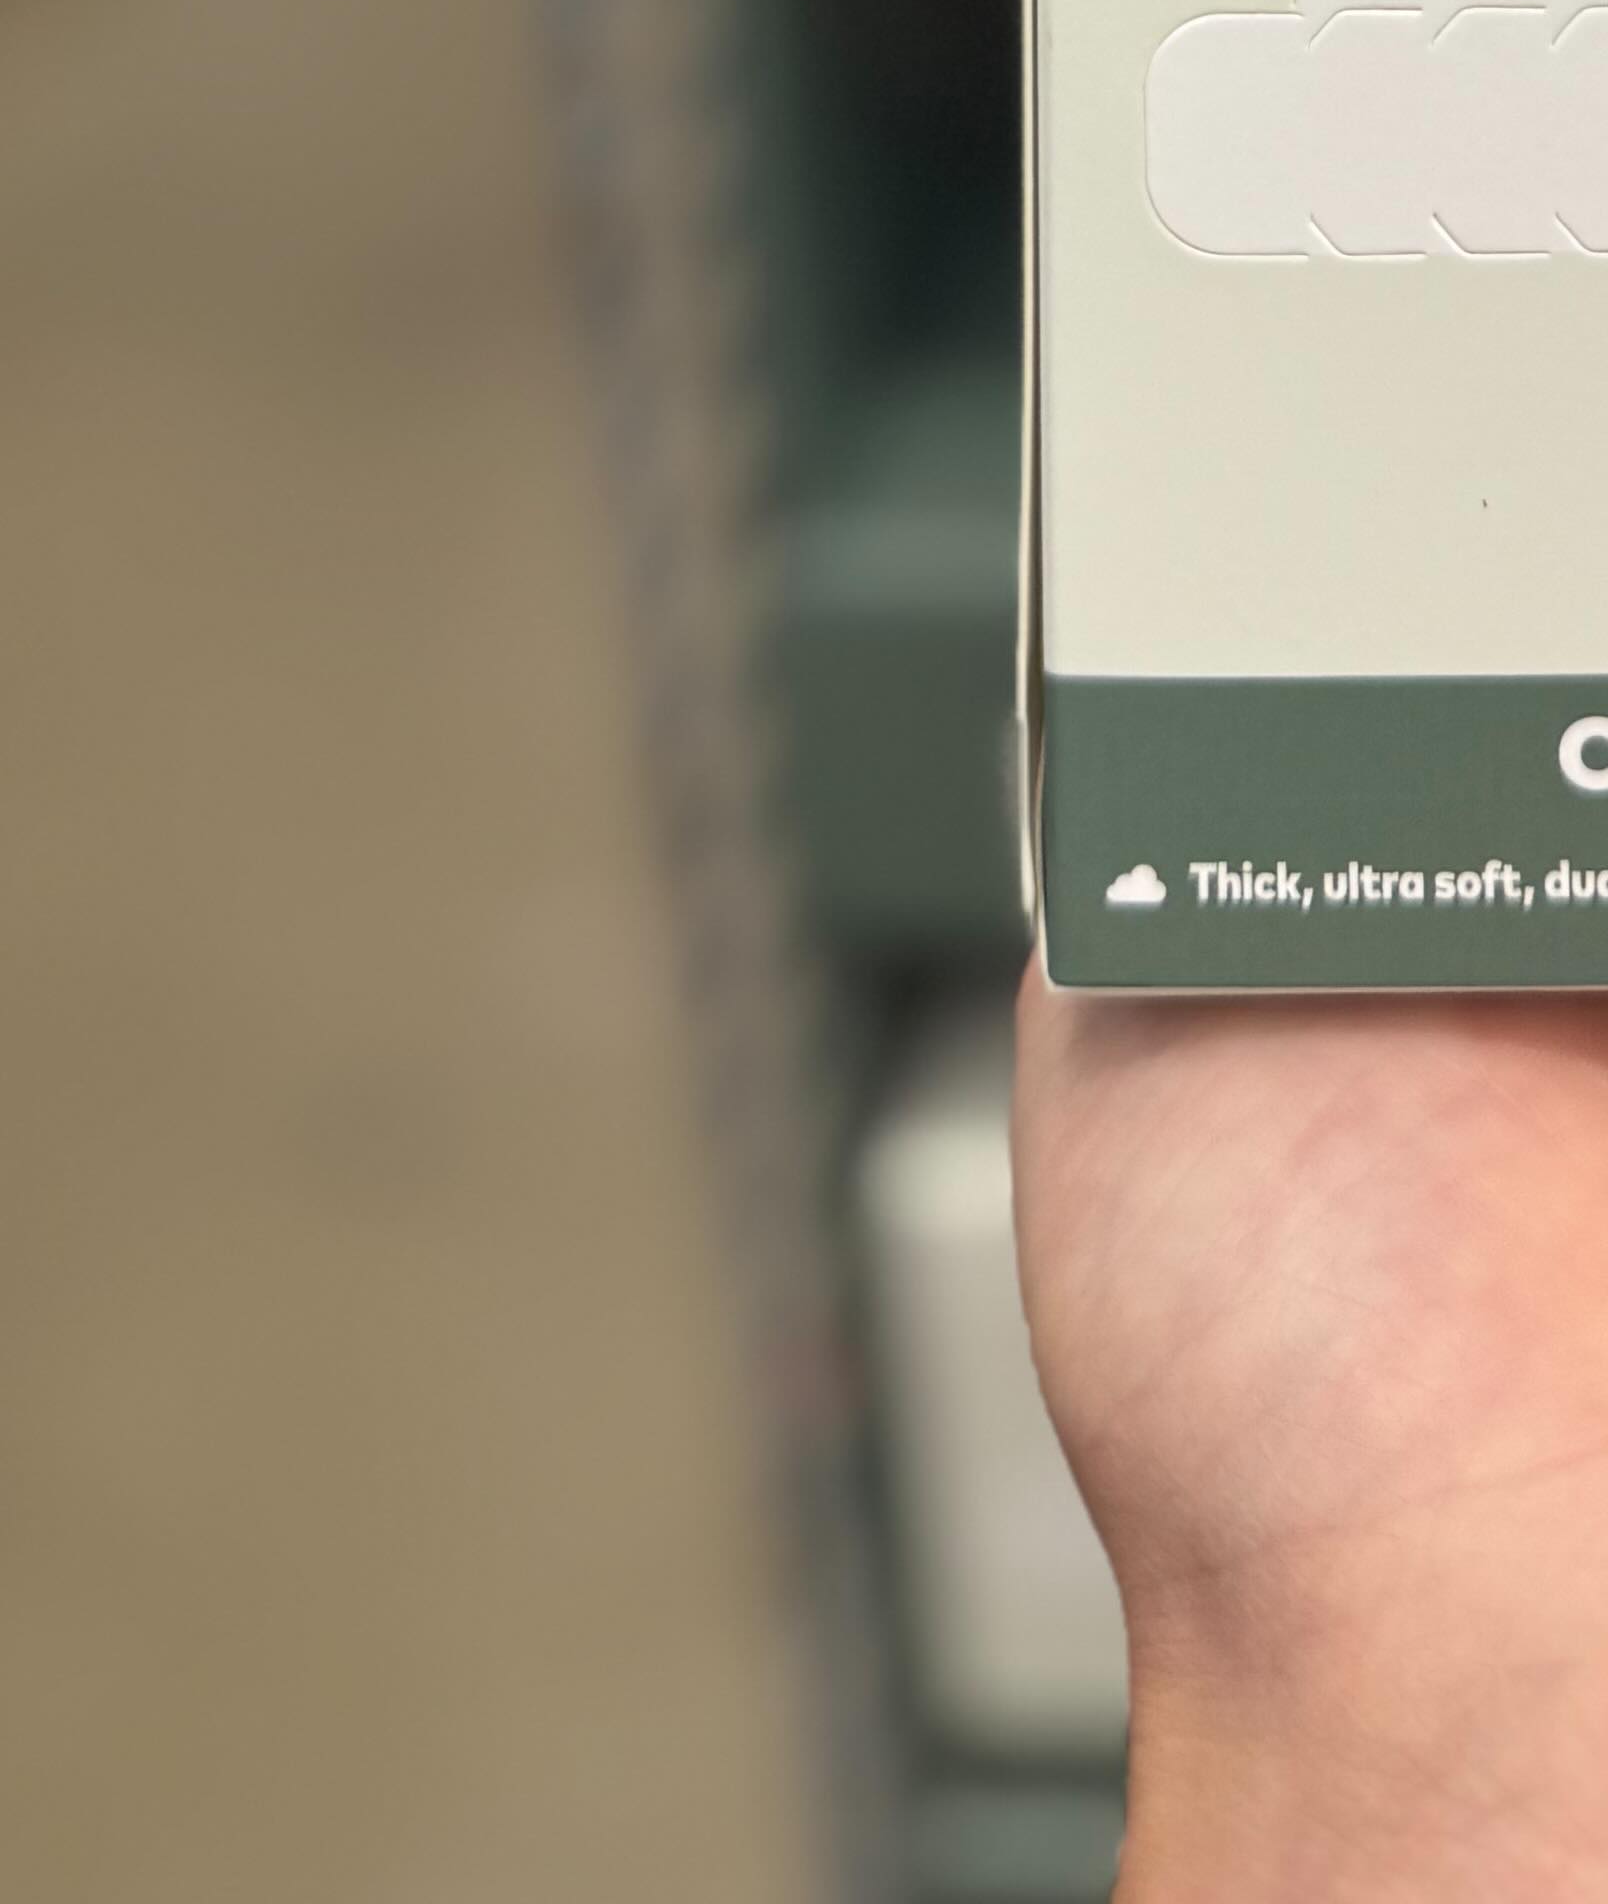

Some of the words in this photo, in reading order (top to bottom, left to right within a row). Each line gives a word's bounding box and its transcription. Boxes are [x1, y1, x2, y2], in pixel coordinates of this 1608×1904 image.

[1188, 859, 1315, 911] Thick,
[1322, 860, 1426, 903] ultra
[1433, 858, 1536, 909] soft,
